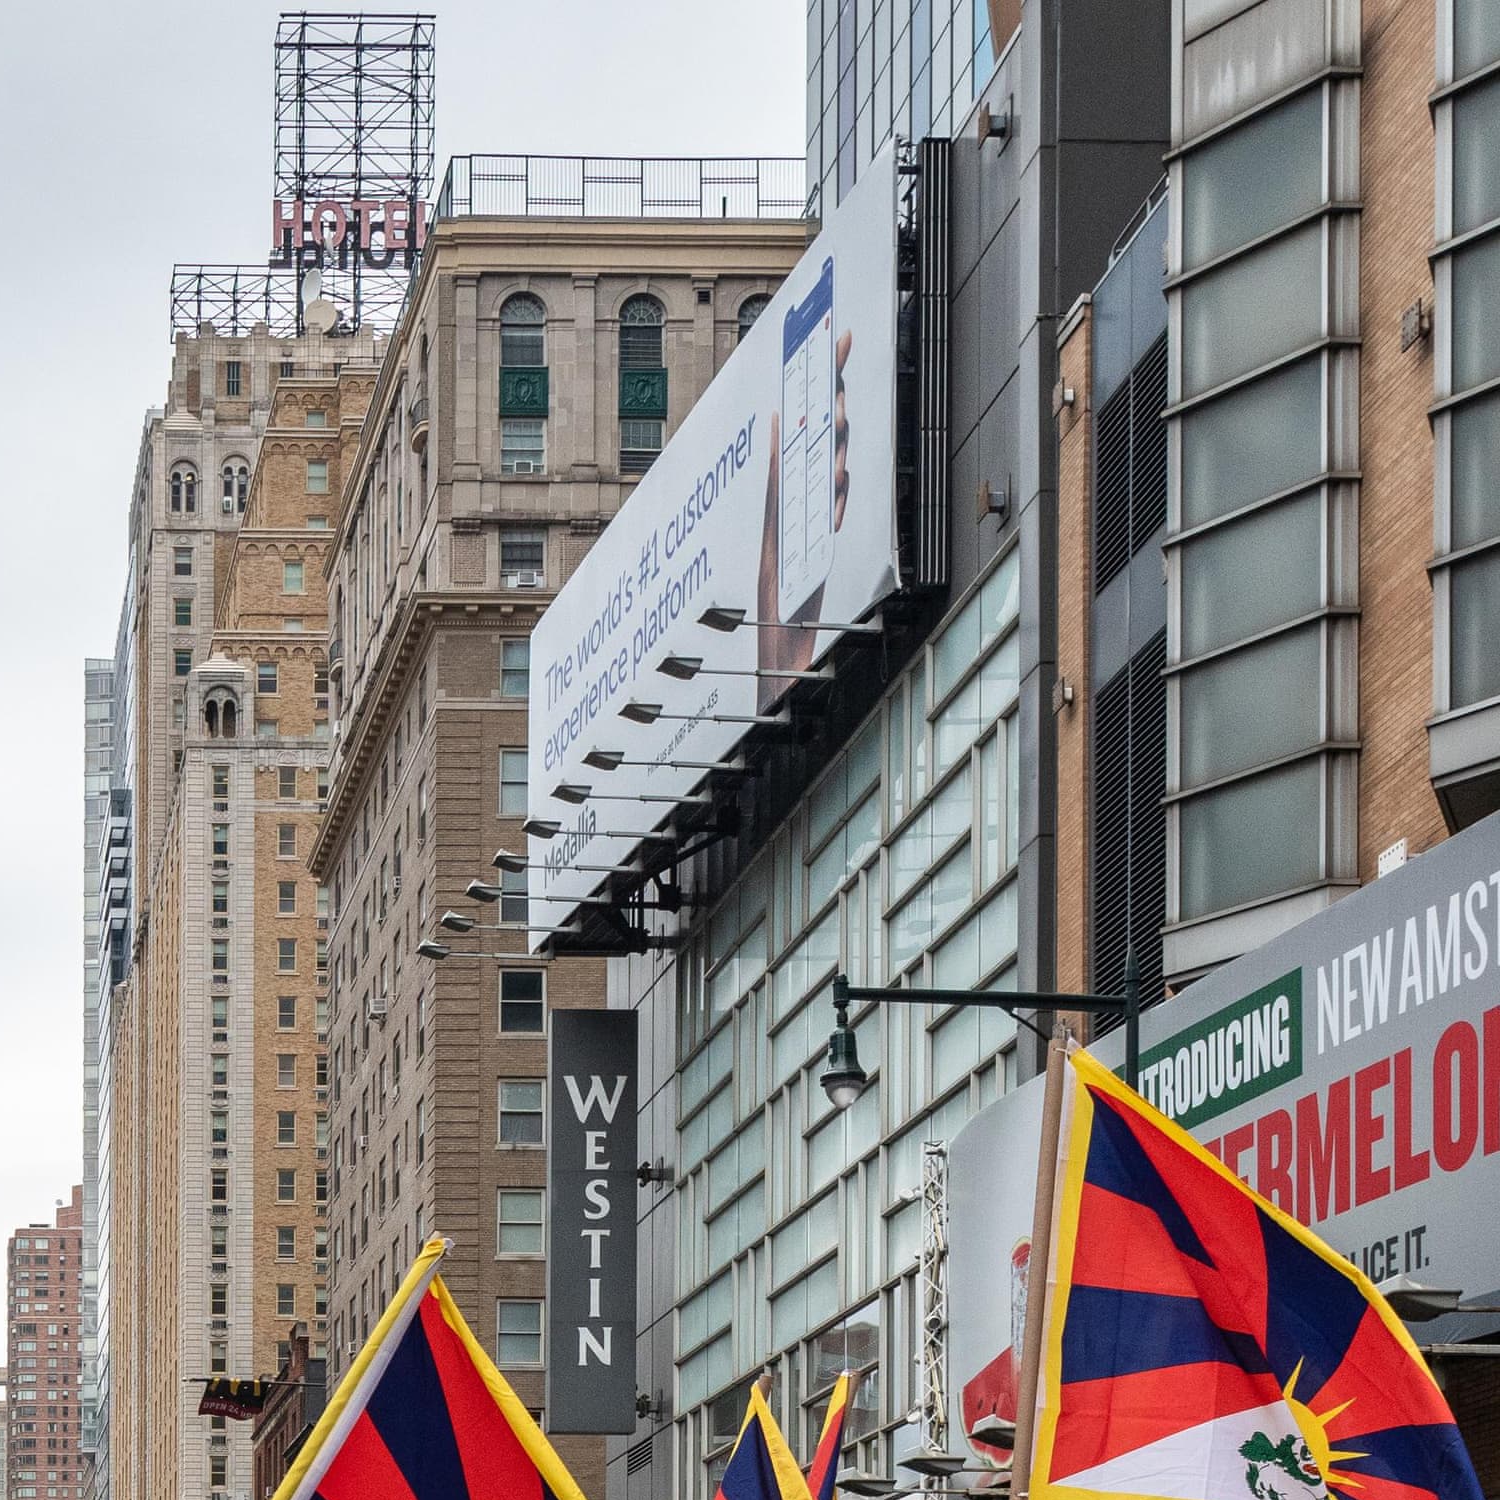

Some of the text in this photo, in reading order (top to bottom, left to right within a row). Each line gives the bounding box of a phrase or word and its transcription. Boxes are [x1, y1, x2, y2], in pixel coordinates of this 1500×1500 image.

[544, 413, 757, 711] The world's #1 customer
[544, 546, 713, 772] experience platform.
[543, 804, 597, 889] Medallia
[1317, 927, 1395, 1056] NEW
[1138, 995, 1290, 1121] TRODUCING
[563, 1075, 628, 1367] WESTIN
[1342, 1225, 1430, 1284] ICE IT.
